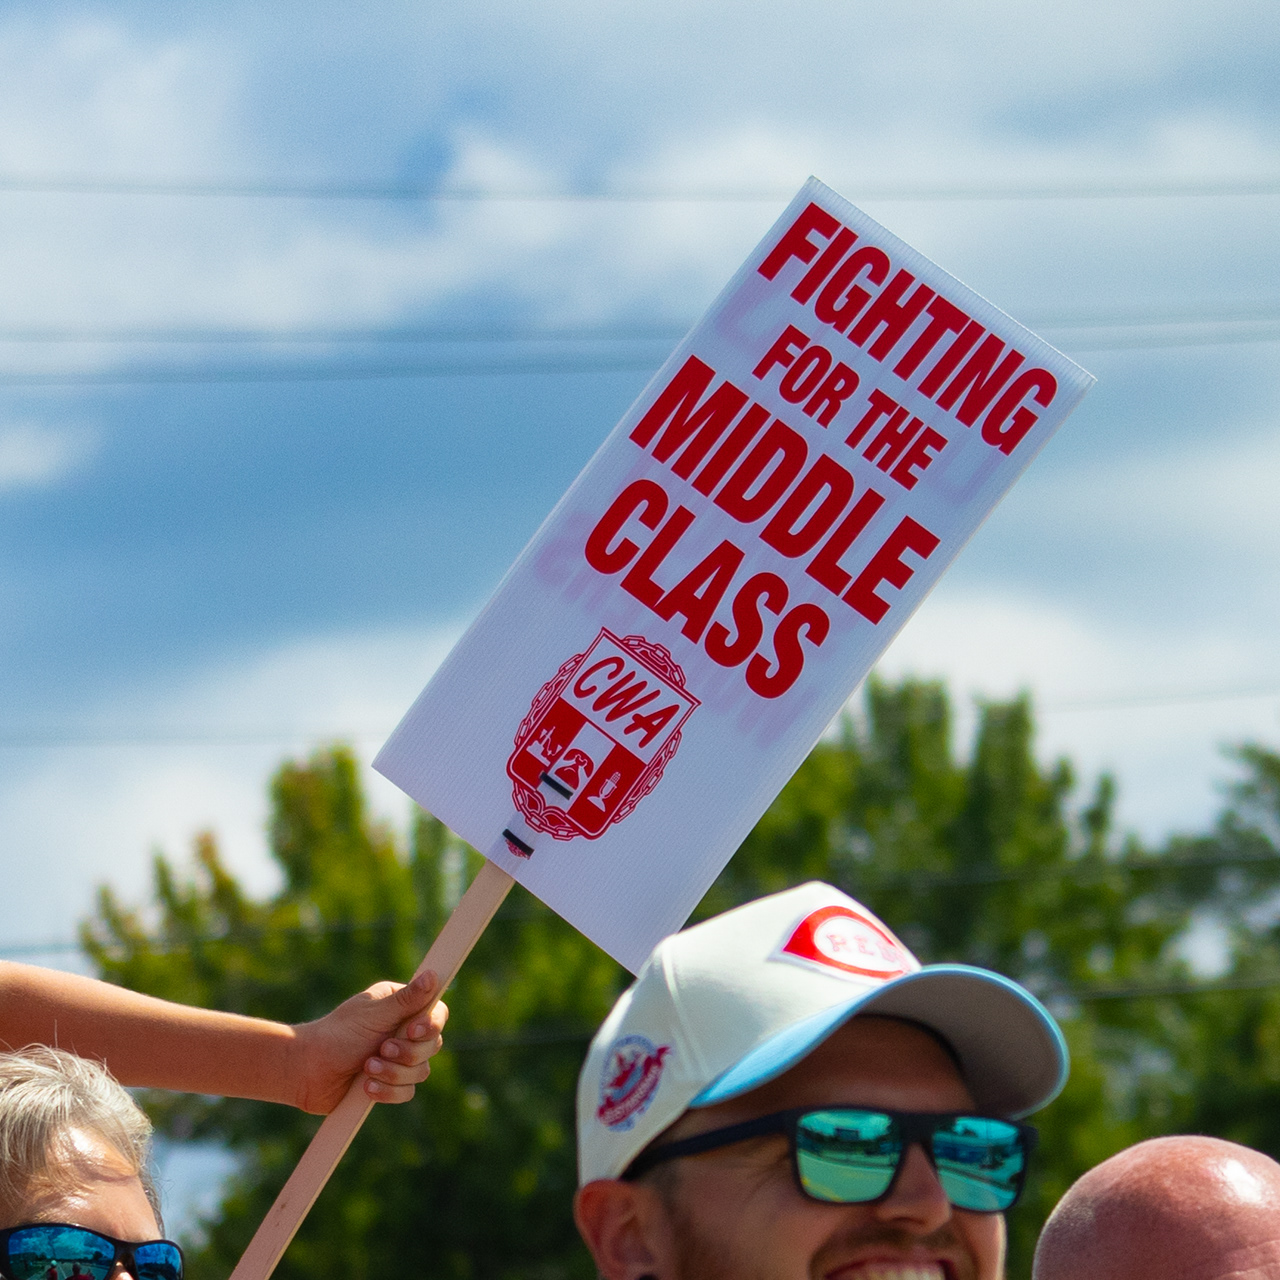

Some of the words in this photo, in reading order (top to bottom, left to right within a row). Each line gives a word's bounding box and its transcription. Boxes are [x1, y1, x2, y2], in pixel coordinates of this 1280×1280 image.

[752, 325, 860, 428] FOR
[844, 389, 947, 490] THE
[757, 202, 1058, 455] FIGHTING
[584, 478, 830, 698] CLASS
[629, 355, 940, 624] MIDDLE
[573, 656, 680, 749] CWA
